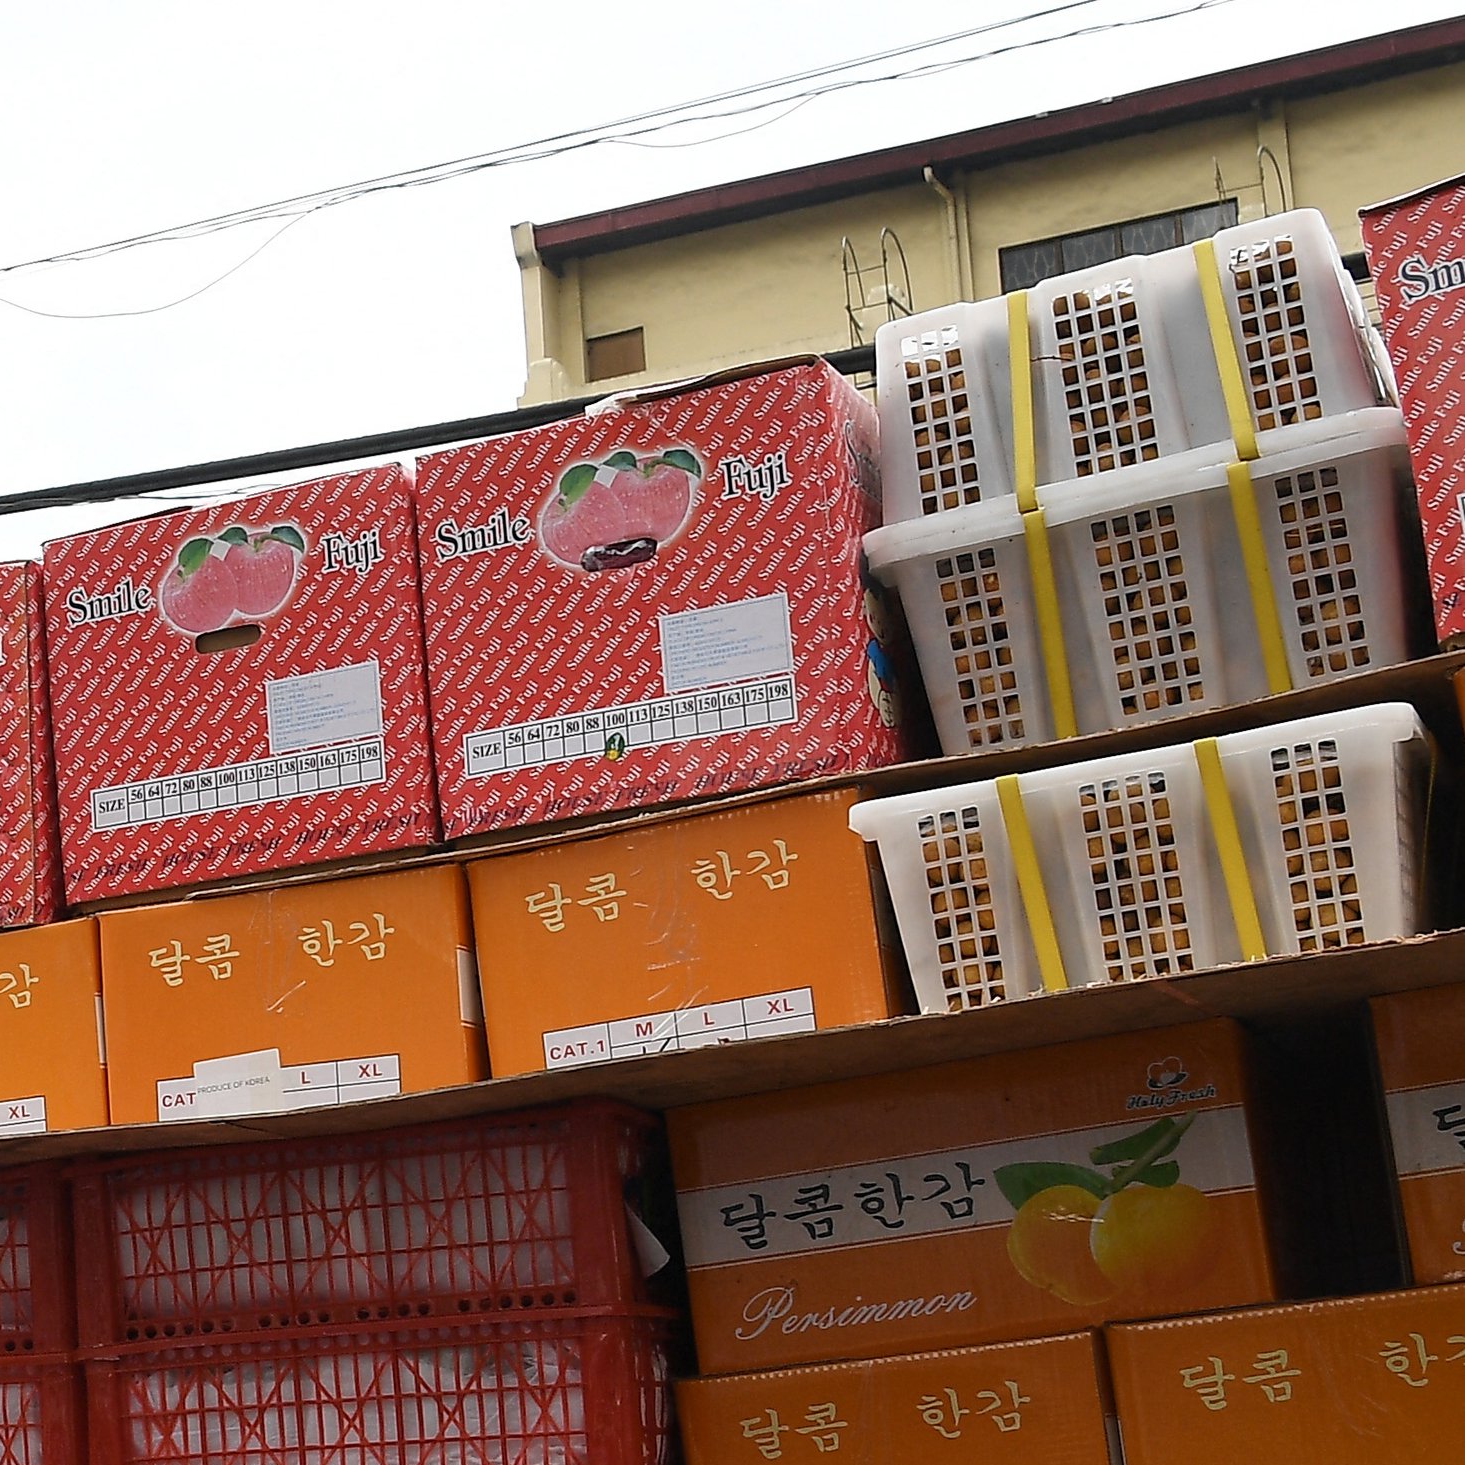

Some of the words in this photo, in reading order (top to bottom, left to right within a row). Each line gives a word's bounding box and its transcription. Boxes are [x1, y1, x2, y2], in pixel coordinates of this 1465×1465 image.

[435, 506, 531, 563] Smile
[720, 452, 790, 500] Fuji
[67, 576, 152, 627] Smile
[322, 530, 383, 575] Fuji
[472, 743, 502, 758] SIZE
[508, 731, 521, 745] 56
[527, 727, 541, 740] 64
[546, 724, 560, 737] 72
[566, 721, 579, 734] 80
[586, 717, 599, 729] 88
[606, 712, 625, 727] 100
[629, 708, 648, 723] 113
[652, 704, 670, 718] 125
[674, 700, 694, 714] 138
[698, 696, 717, 710] 150
[721, 692, 741, 707] 163
[745, 687, 764, 702] 175
[769, 683, 788, 698] 198
[524, 872, 628, 932] 달콤
[690, 839, 799, 900] 한감
[148, 934, 240, 987] 달콤
[298, 913, 395, 967] 한감
[550, 1040, 605, 1060] CAT.1
[636, 1022, 652, 1036] M
[704, 1012, 714, 1026] L
[767, 998, 794, 1014] XL
[197, 1083, 231, 1094] PRODUCE
[234, 1080, 243, 1089] OF
[245, 1076, 270, 1086] KOREA
[302, 1072, 310, 1084] L
[358, 1063, 382, 1077] XL
[8, 1105, 30, 1118] XL
[719, 1160, 985, 1251] 달콤한감
[734, 1285, 978, 1341] Persimmon
[1179, 1348, 1302, 1411] 달콤
[739, 1401, 848, 1460] 달콤
[916, 1380, 1031, 1439] 한감
